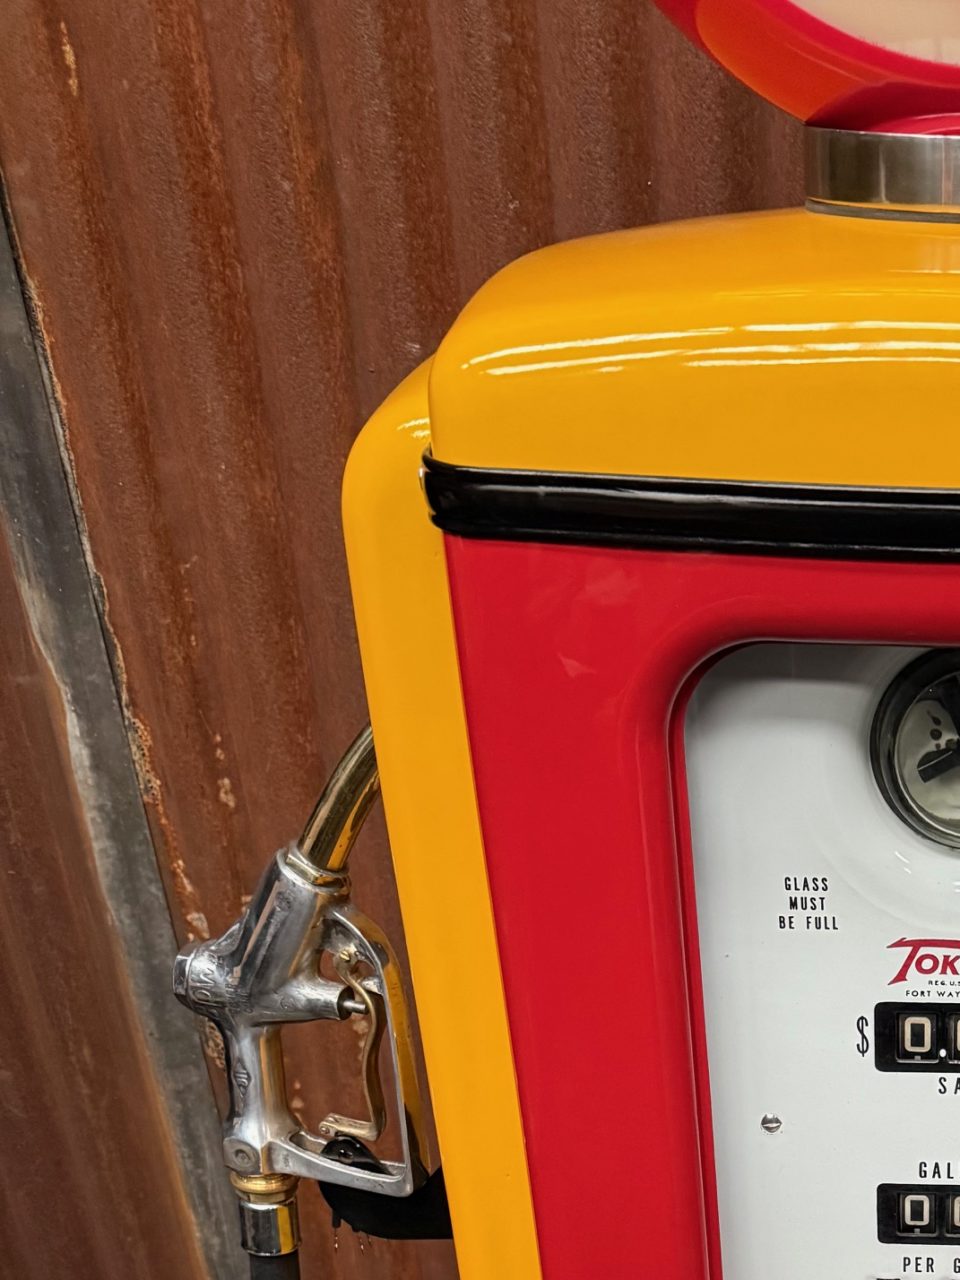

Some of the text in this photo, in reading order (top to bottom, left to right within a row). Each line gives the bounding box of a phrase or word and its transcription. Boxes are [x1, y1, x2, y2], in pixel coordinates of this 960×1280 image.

[784, 876, 829, 892] GLASS
[788, 896, 827, 912] MUST
[778, 915, 839, 931] BE FULL
[905, 989, 931, 998] FORT
[856, 1015, 870, 1058] $
[902, 1256, 935, 1274] PER
